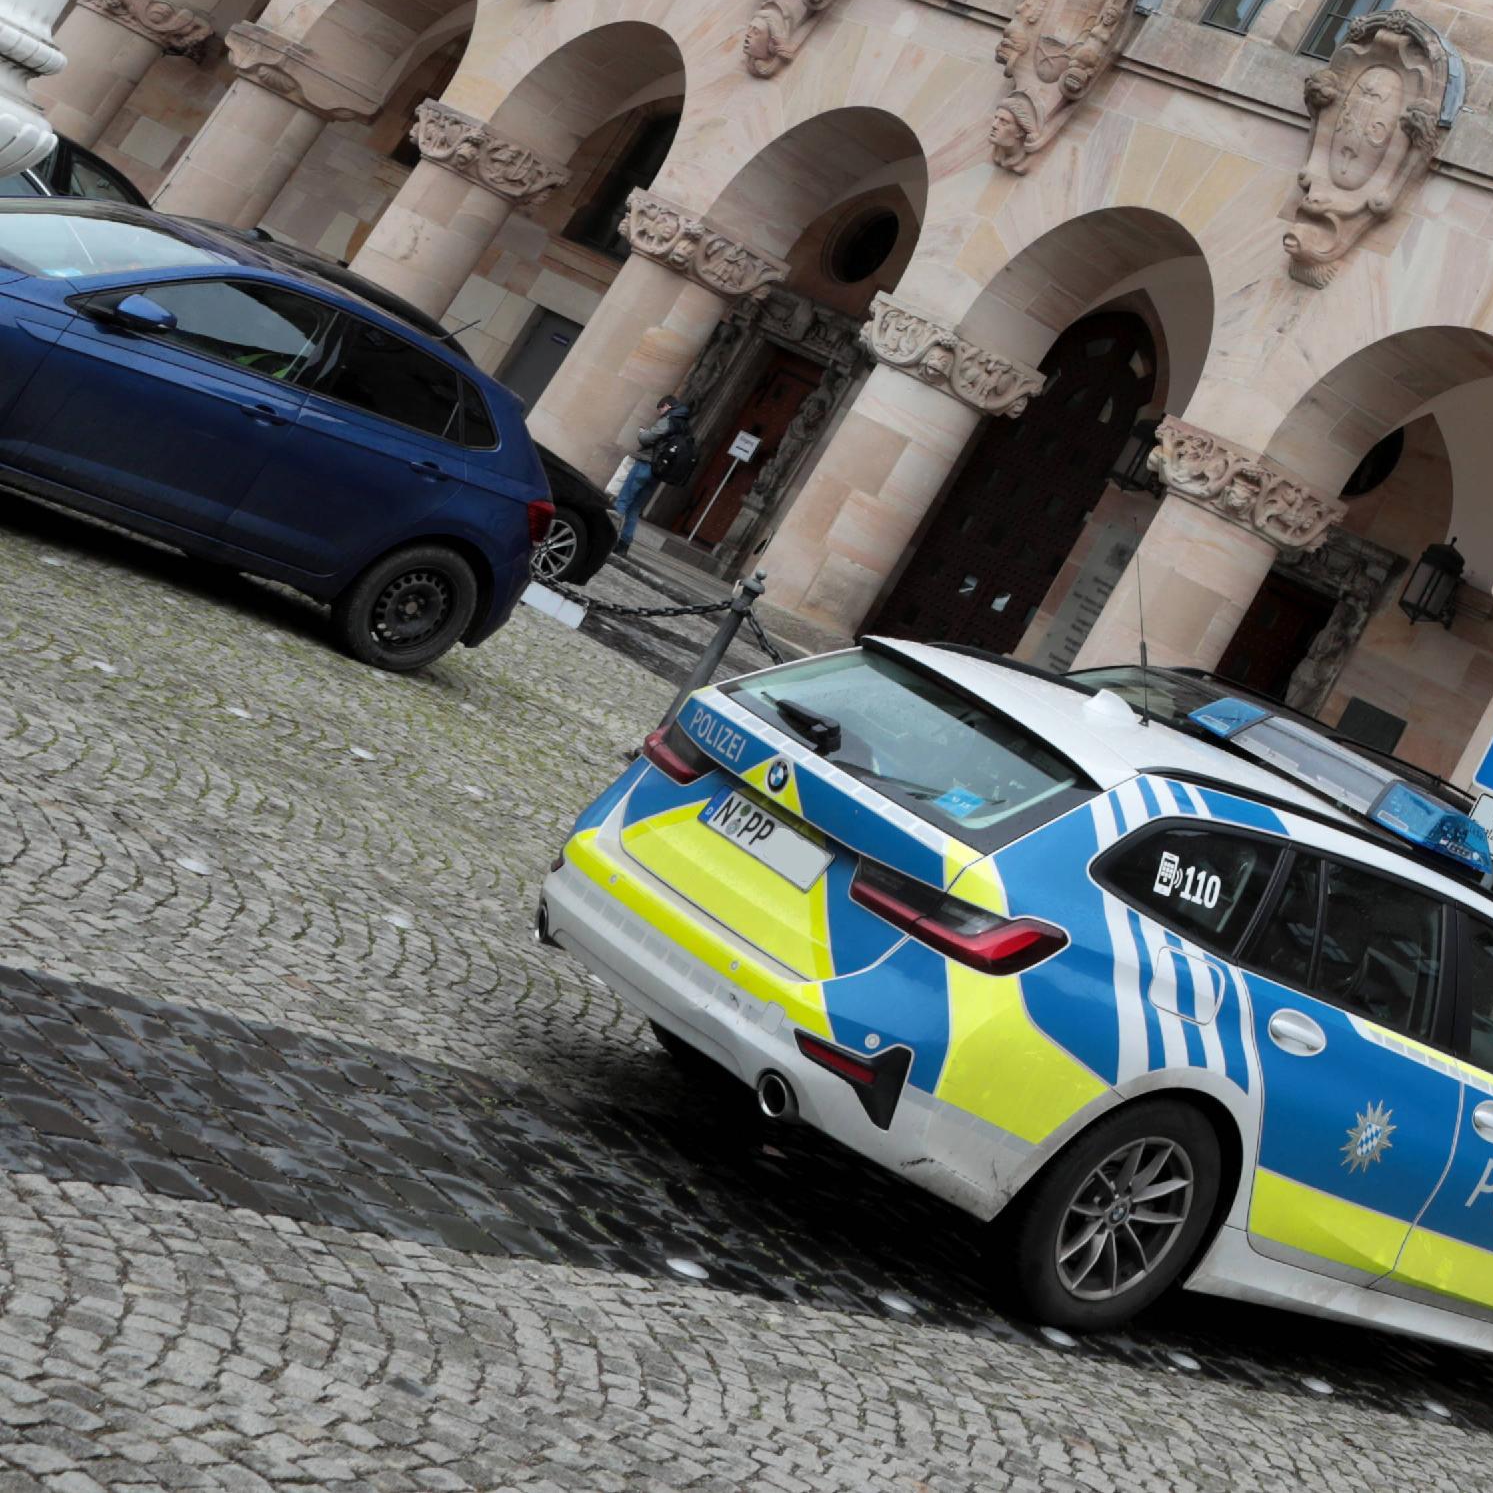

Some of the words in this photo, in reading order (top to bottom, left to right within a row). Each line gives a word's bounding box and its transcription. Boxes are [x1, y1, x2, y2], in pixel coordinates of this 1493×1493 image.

[689, 707, 747, 763] POLIZEI
[712, 796, 742, 827] N
[736, 811, 775, 846] PP
[1180, 866, 1221, 909] 110
